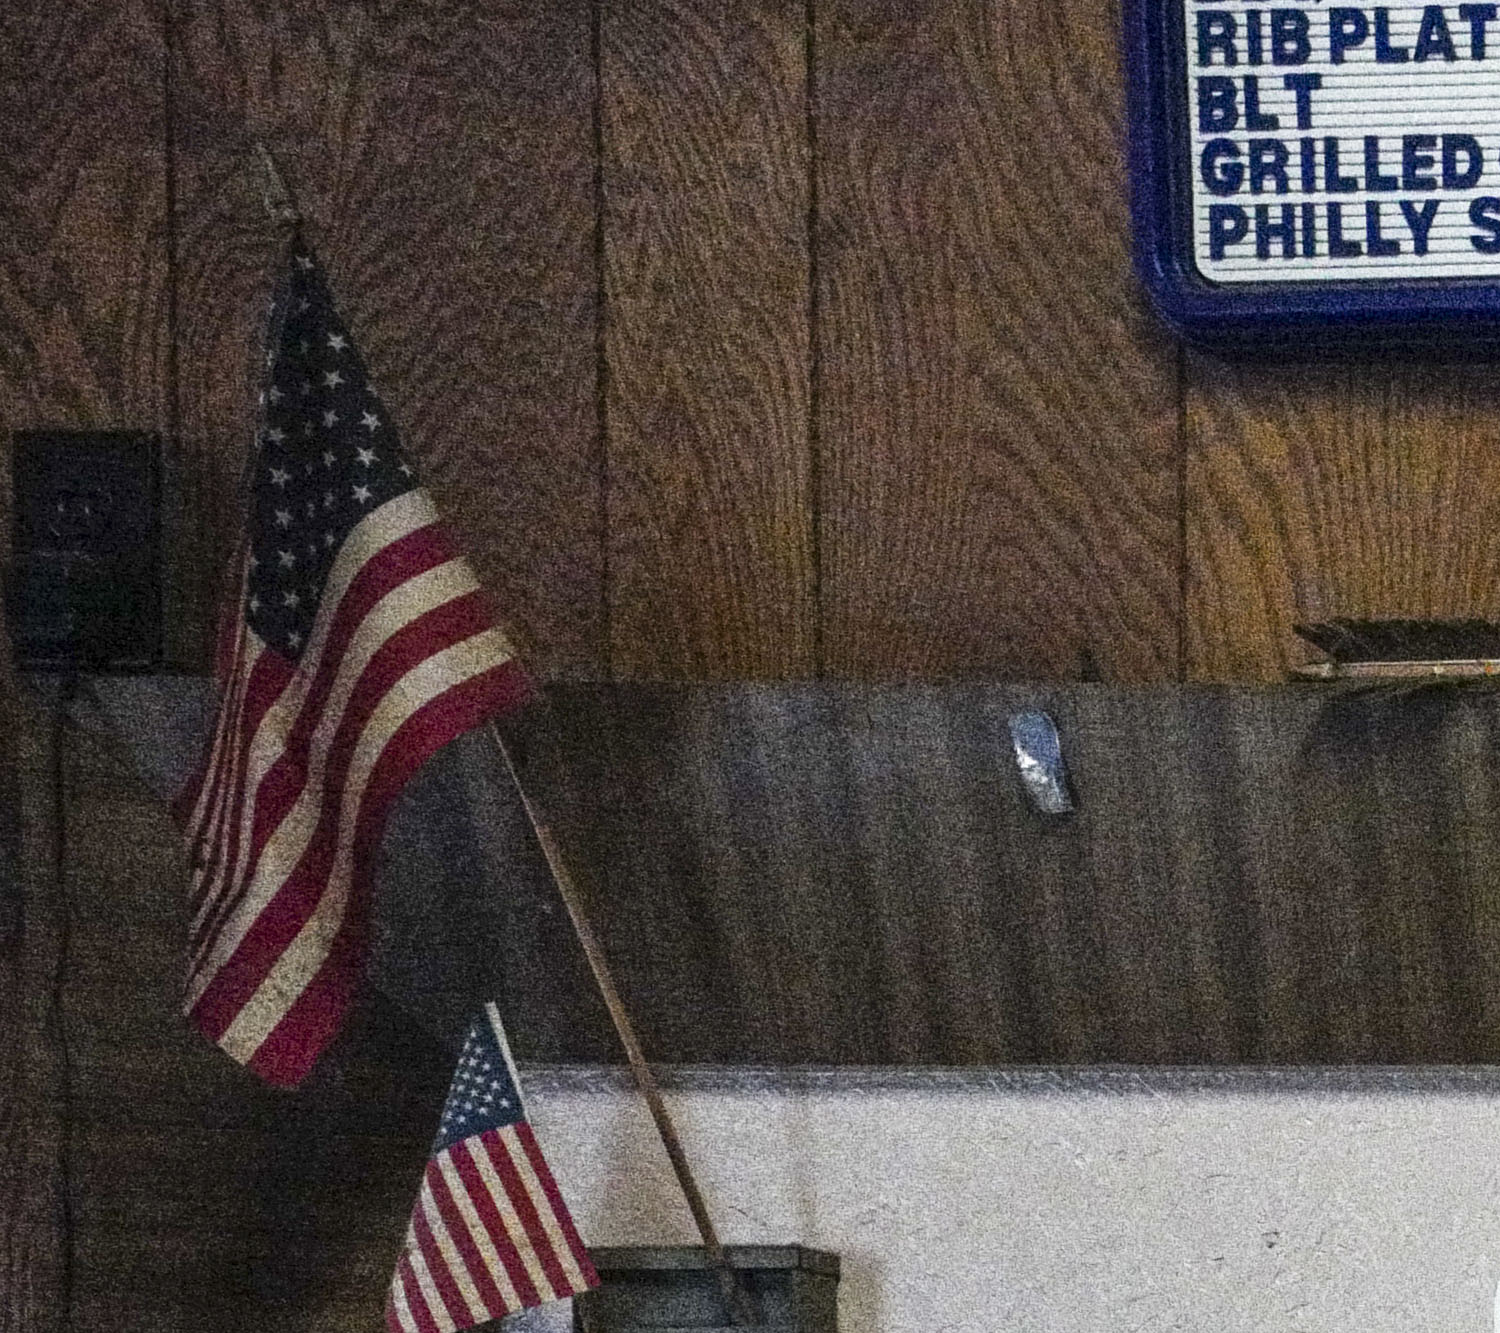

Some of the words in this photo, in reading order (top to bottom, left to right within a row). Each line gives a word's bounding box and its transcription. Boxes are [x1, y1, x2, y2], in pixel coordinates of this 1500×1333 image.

[1197, 8, 1311, 67] RIB
[1197, 73, 1323, 133] BLT
[1200, 132, 1484, 196] GRILLED
[1208, 198, 1443, 262] PHILLY
